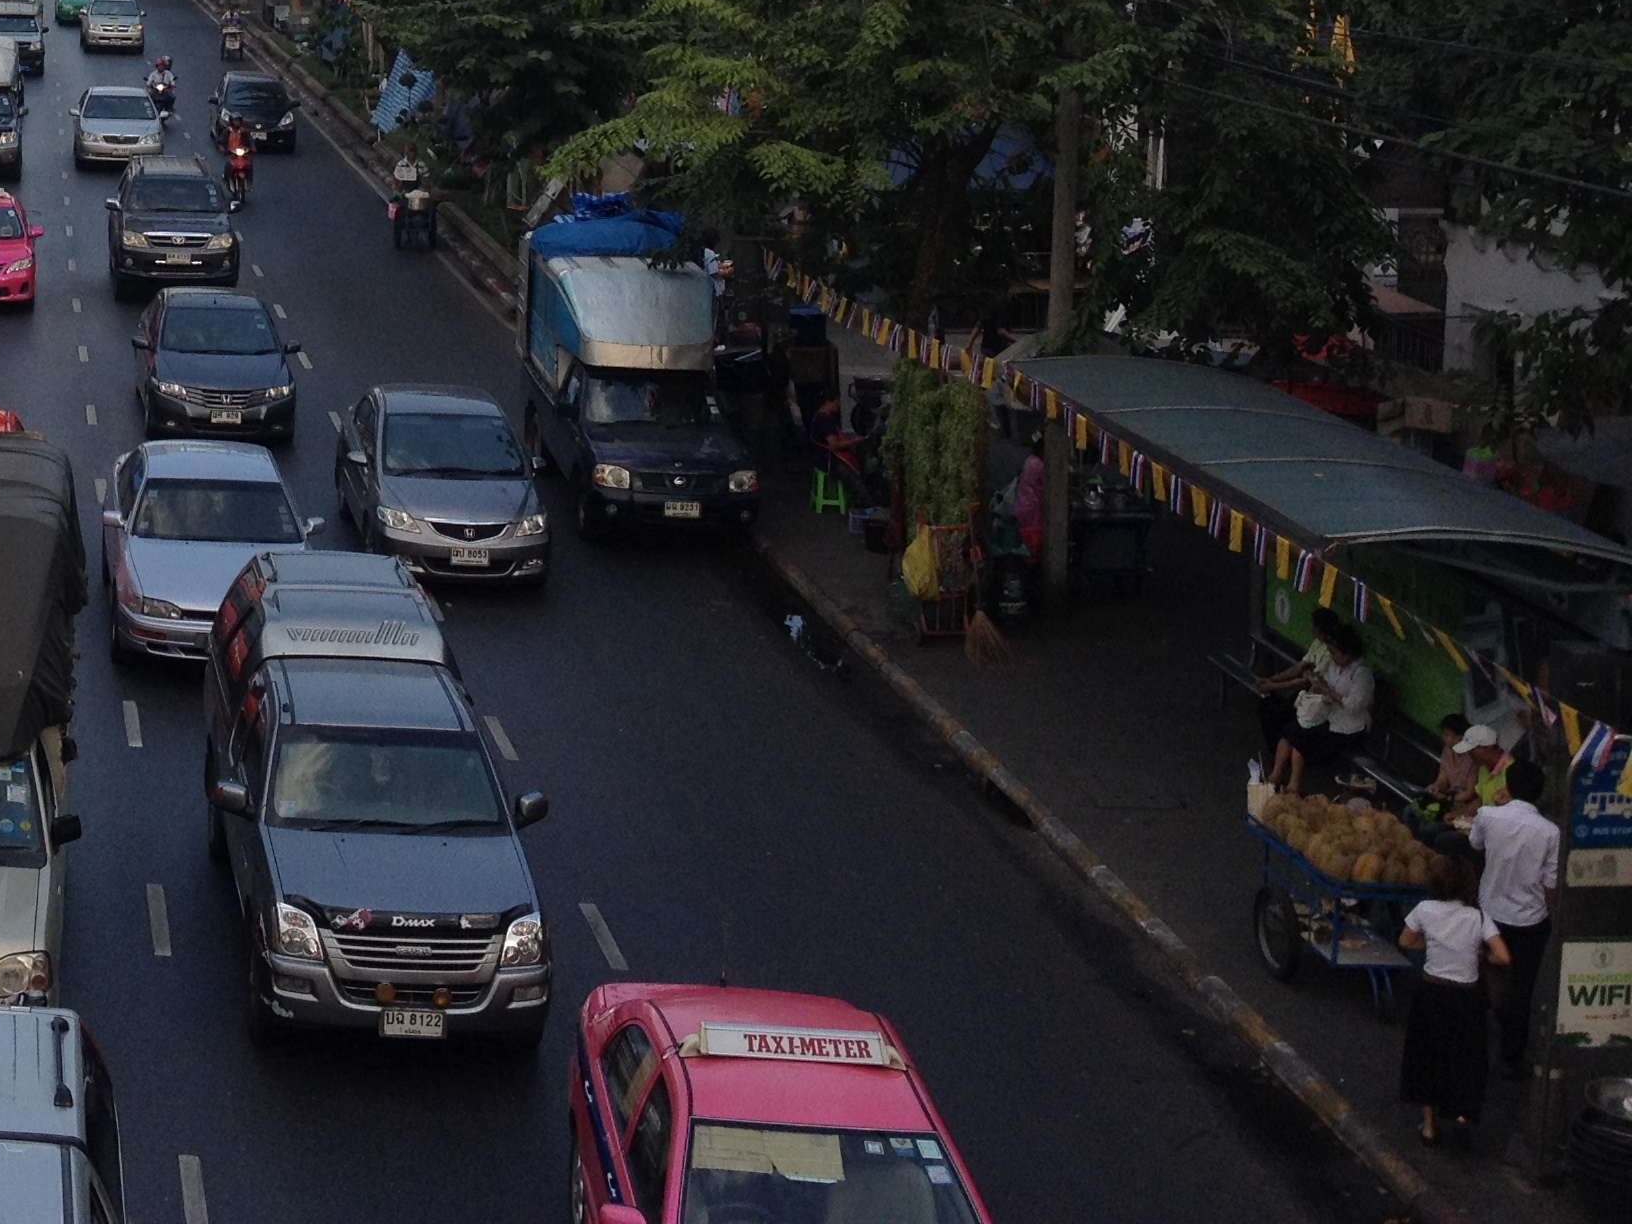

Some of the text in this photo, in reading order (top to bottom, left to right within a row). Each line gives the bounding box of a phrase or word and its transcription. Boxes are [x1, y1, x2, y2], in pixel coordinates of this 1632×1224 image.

[1567, 984, 1631, 1007] WIFI
[386, 1012, 441, 1027] บฉ 8122
[744, 1033, 873, 1060] TAXI-METER
